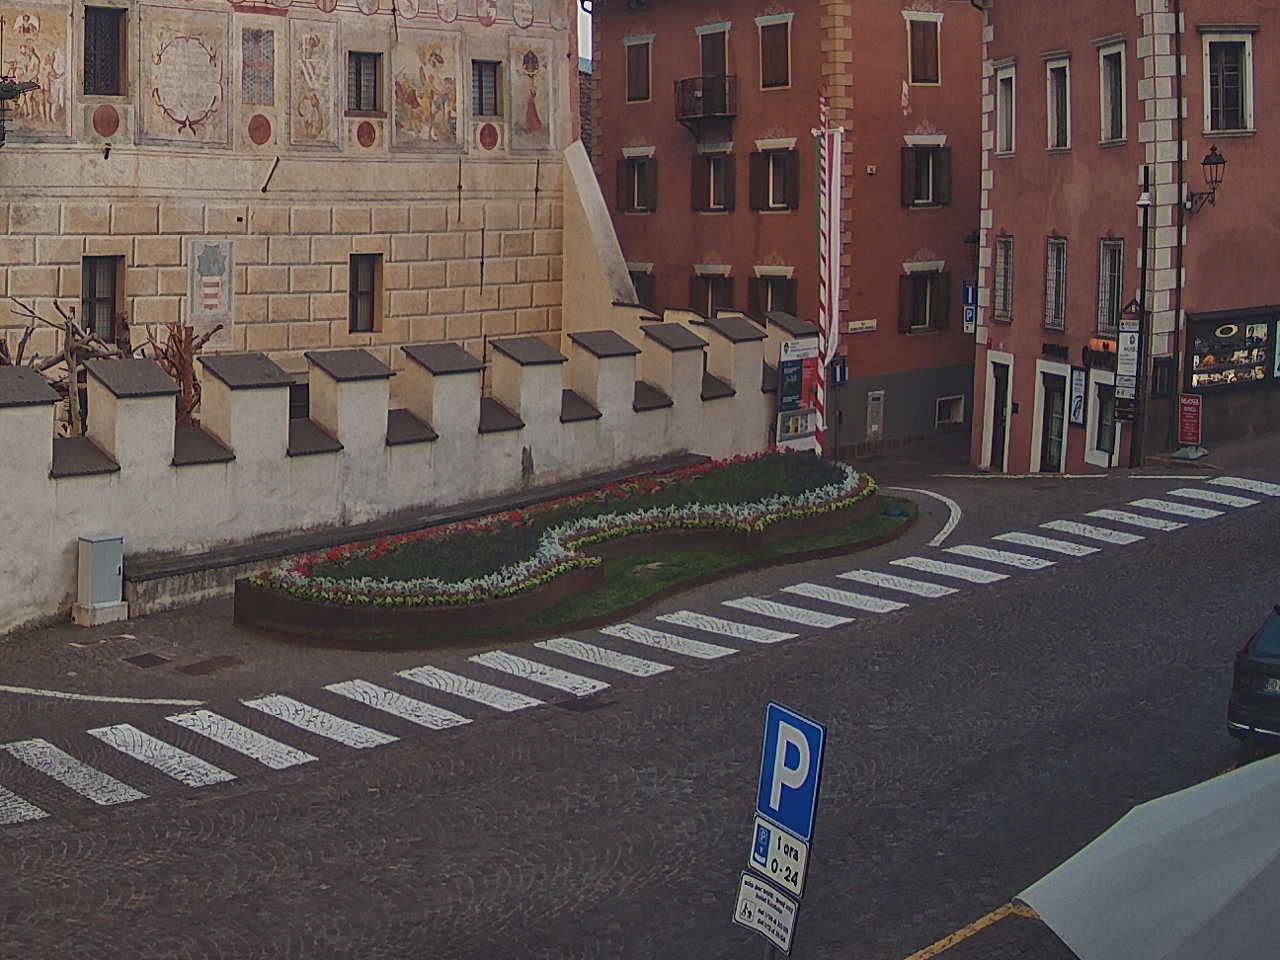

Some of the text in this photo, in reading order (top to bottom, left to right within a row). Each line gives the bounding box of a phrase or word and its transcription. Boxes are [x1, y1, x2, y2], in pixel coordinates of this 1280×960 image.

[769, 720, 810, 812] P
[776, 835, 799, 862] 1 ora
